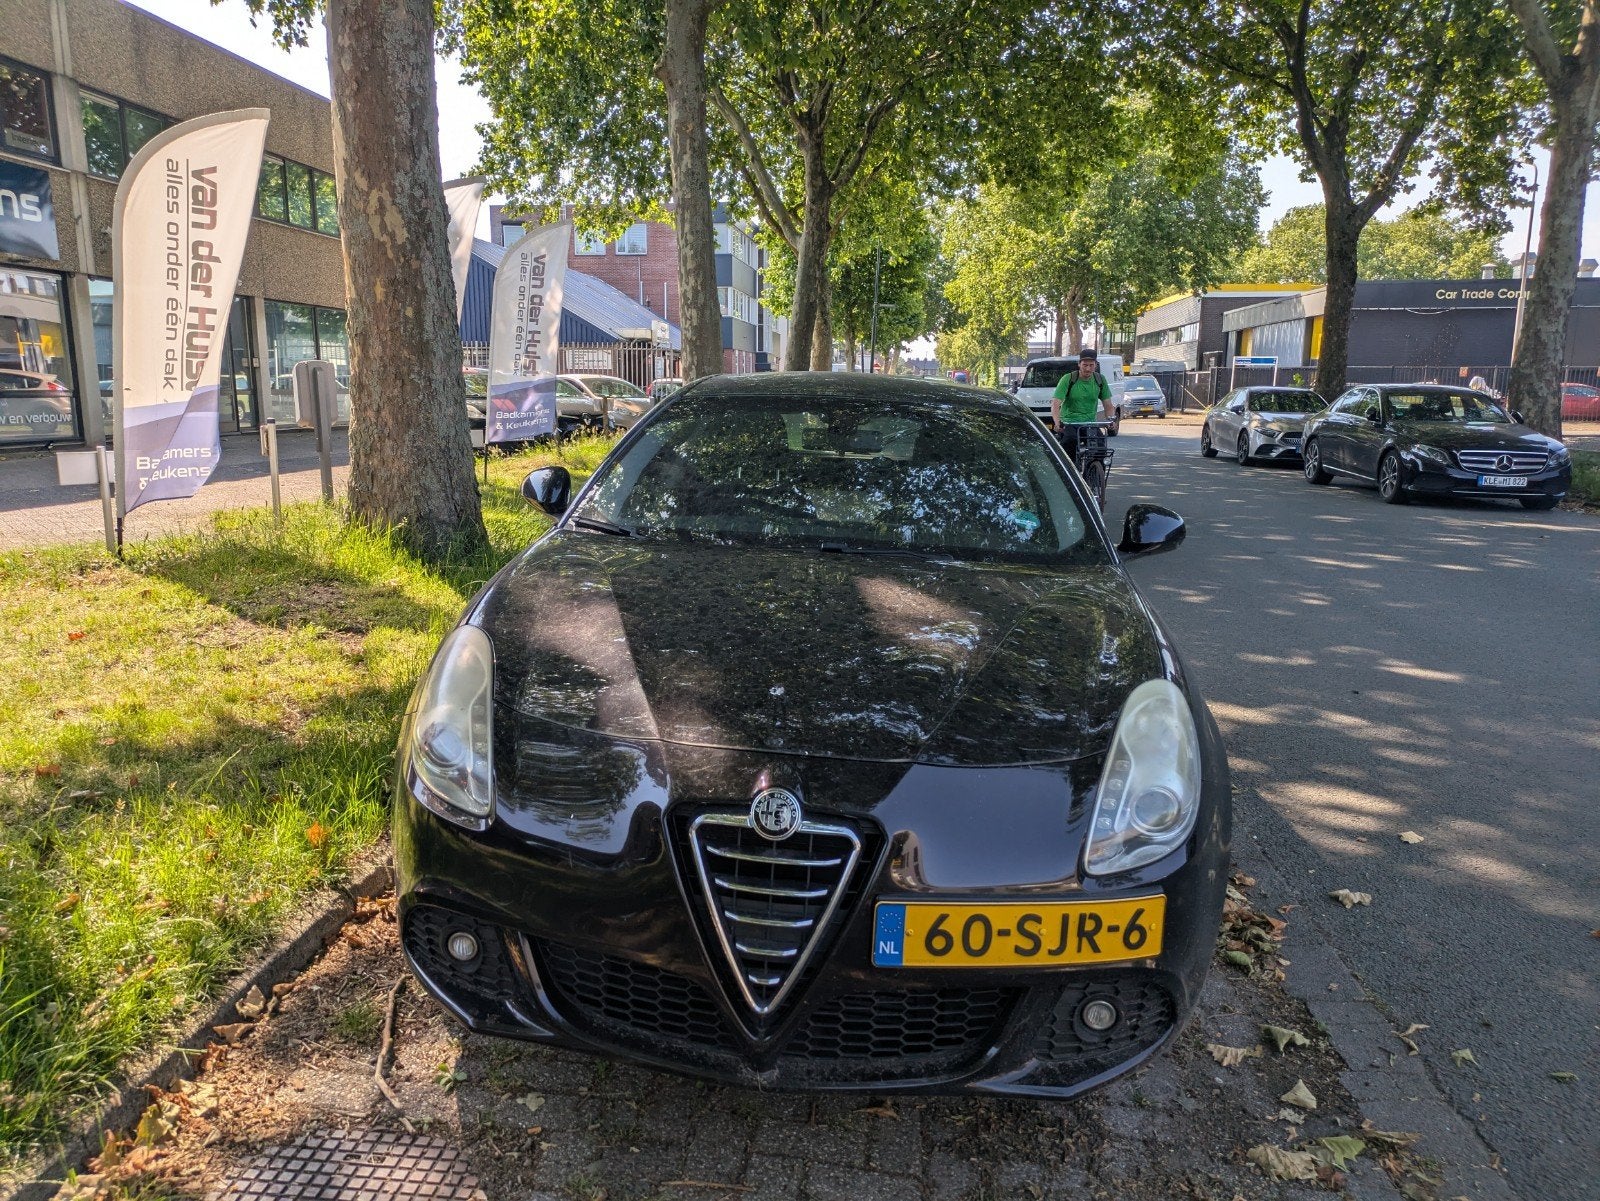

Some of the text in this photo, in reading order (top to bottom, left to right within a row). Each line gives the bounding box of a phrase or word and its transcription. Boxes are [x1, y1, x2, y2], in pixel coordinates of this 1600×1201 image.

[0, 189, 43, 222] ns
[191, 165, 218, 230] van
[162, 158, 184, 390] alles onder één dak
[190, 240, 222, 298] der
[519, 252, 530, 282] alles
[516, 285, 527, 323] onder
[1435, 289, 1458, 300] Car
[1461, 288, 1495, 300] Trade
[522, 253, 547, 377] van der Hulst
[512, 353, 522, 376] dak
[9, 415, 24, 424] en
[26, 412, 72, 424] verbouw
[496, 417, 548, 430] & Keukens
[149, 465, 211, 482] eukens
[879, 940, 899, 955] NL
[924, 907, 1148, 957] 60-SJR-6
